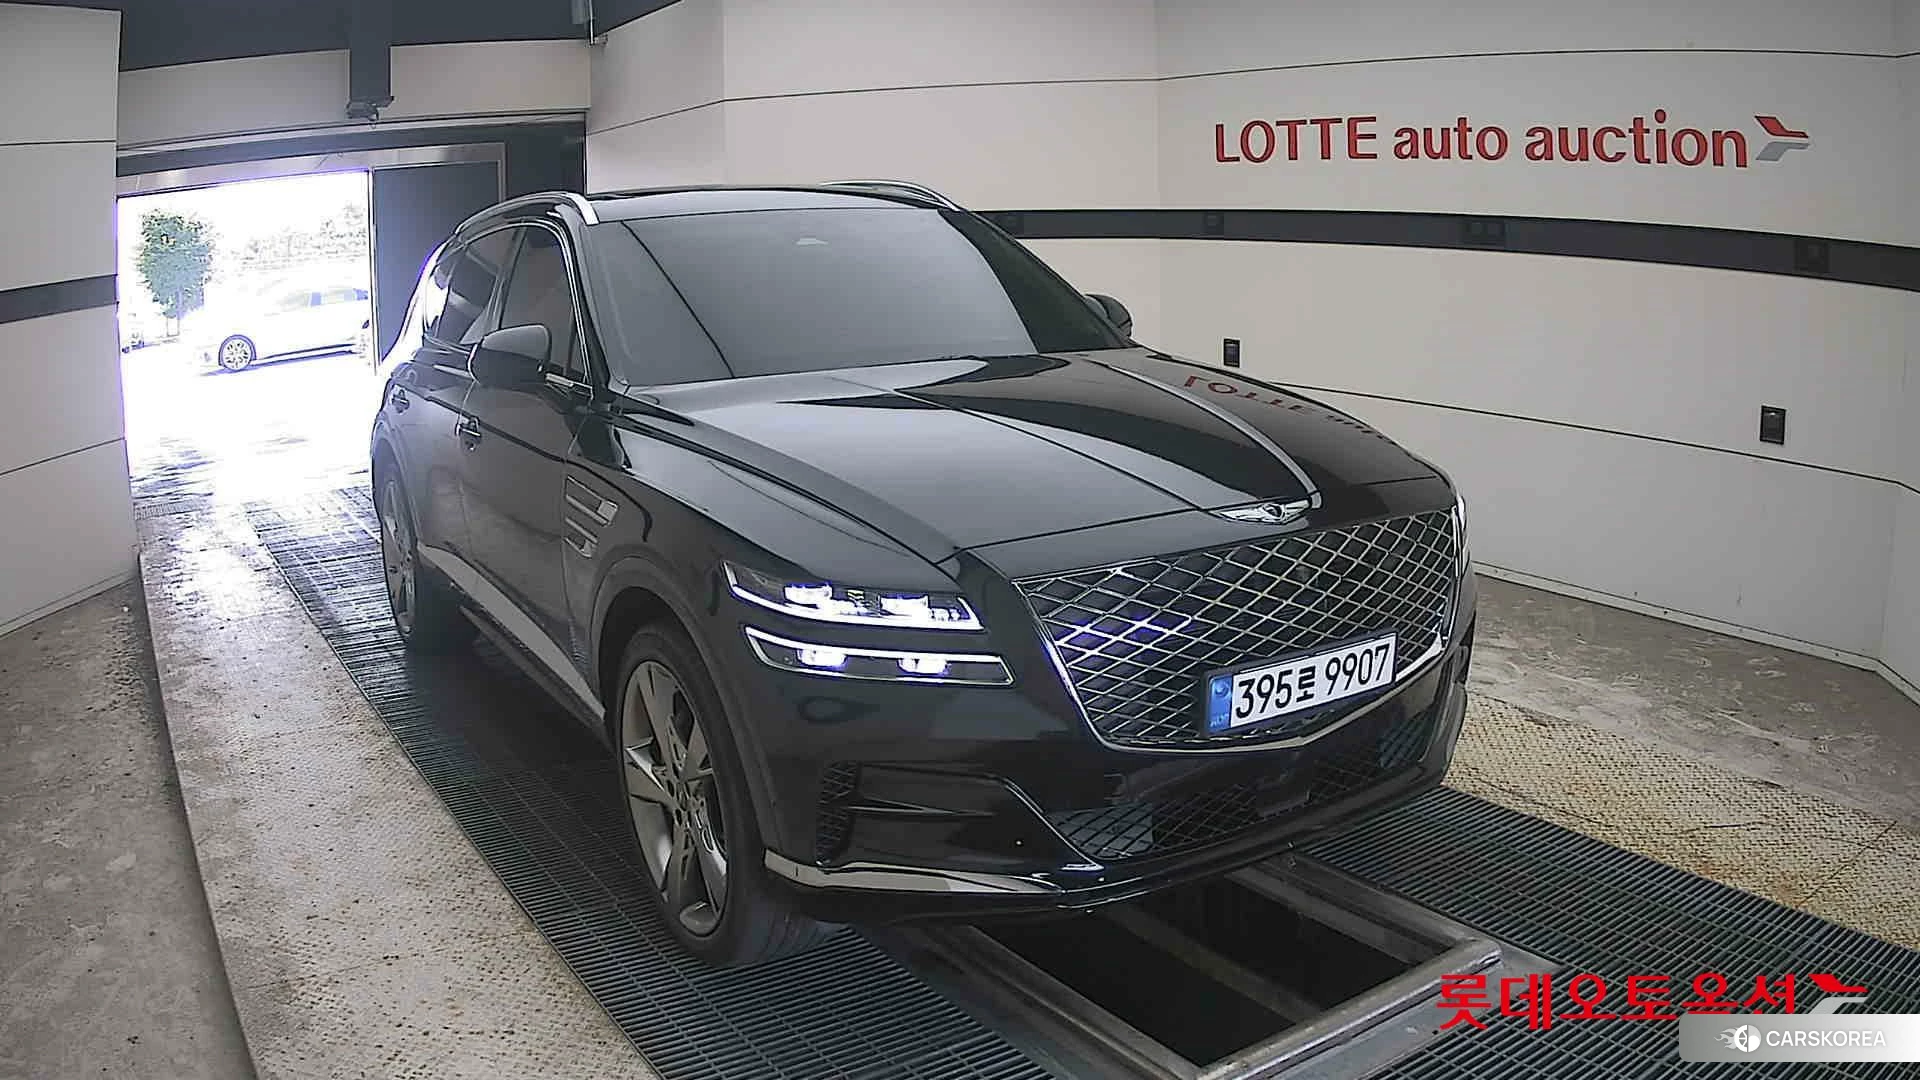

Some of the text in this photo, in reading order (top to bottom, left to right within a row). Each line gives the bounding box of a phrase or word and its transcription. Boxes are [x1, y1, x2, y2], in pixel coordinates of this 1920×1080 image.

[1214, 109, 1749, 168] LOTTE auto auction
[1235, 643, 1390, 719] 395로 9907
